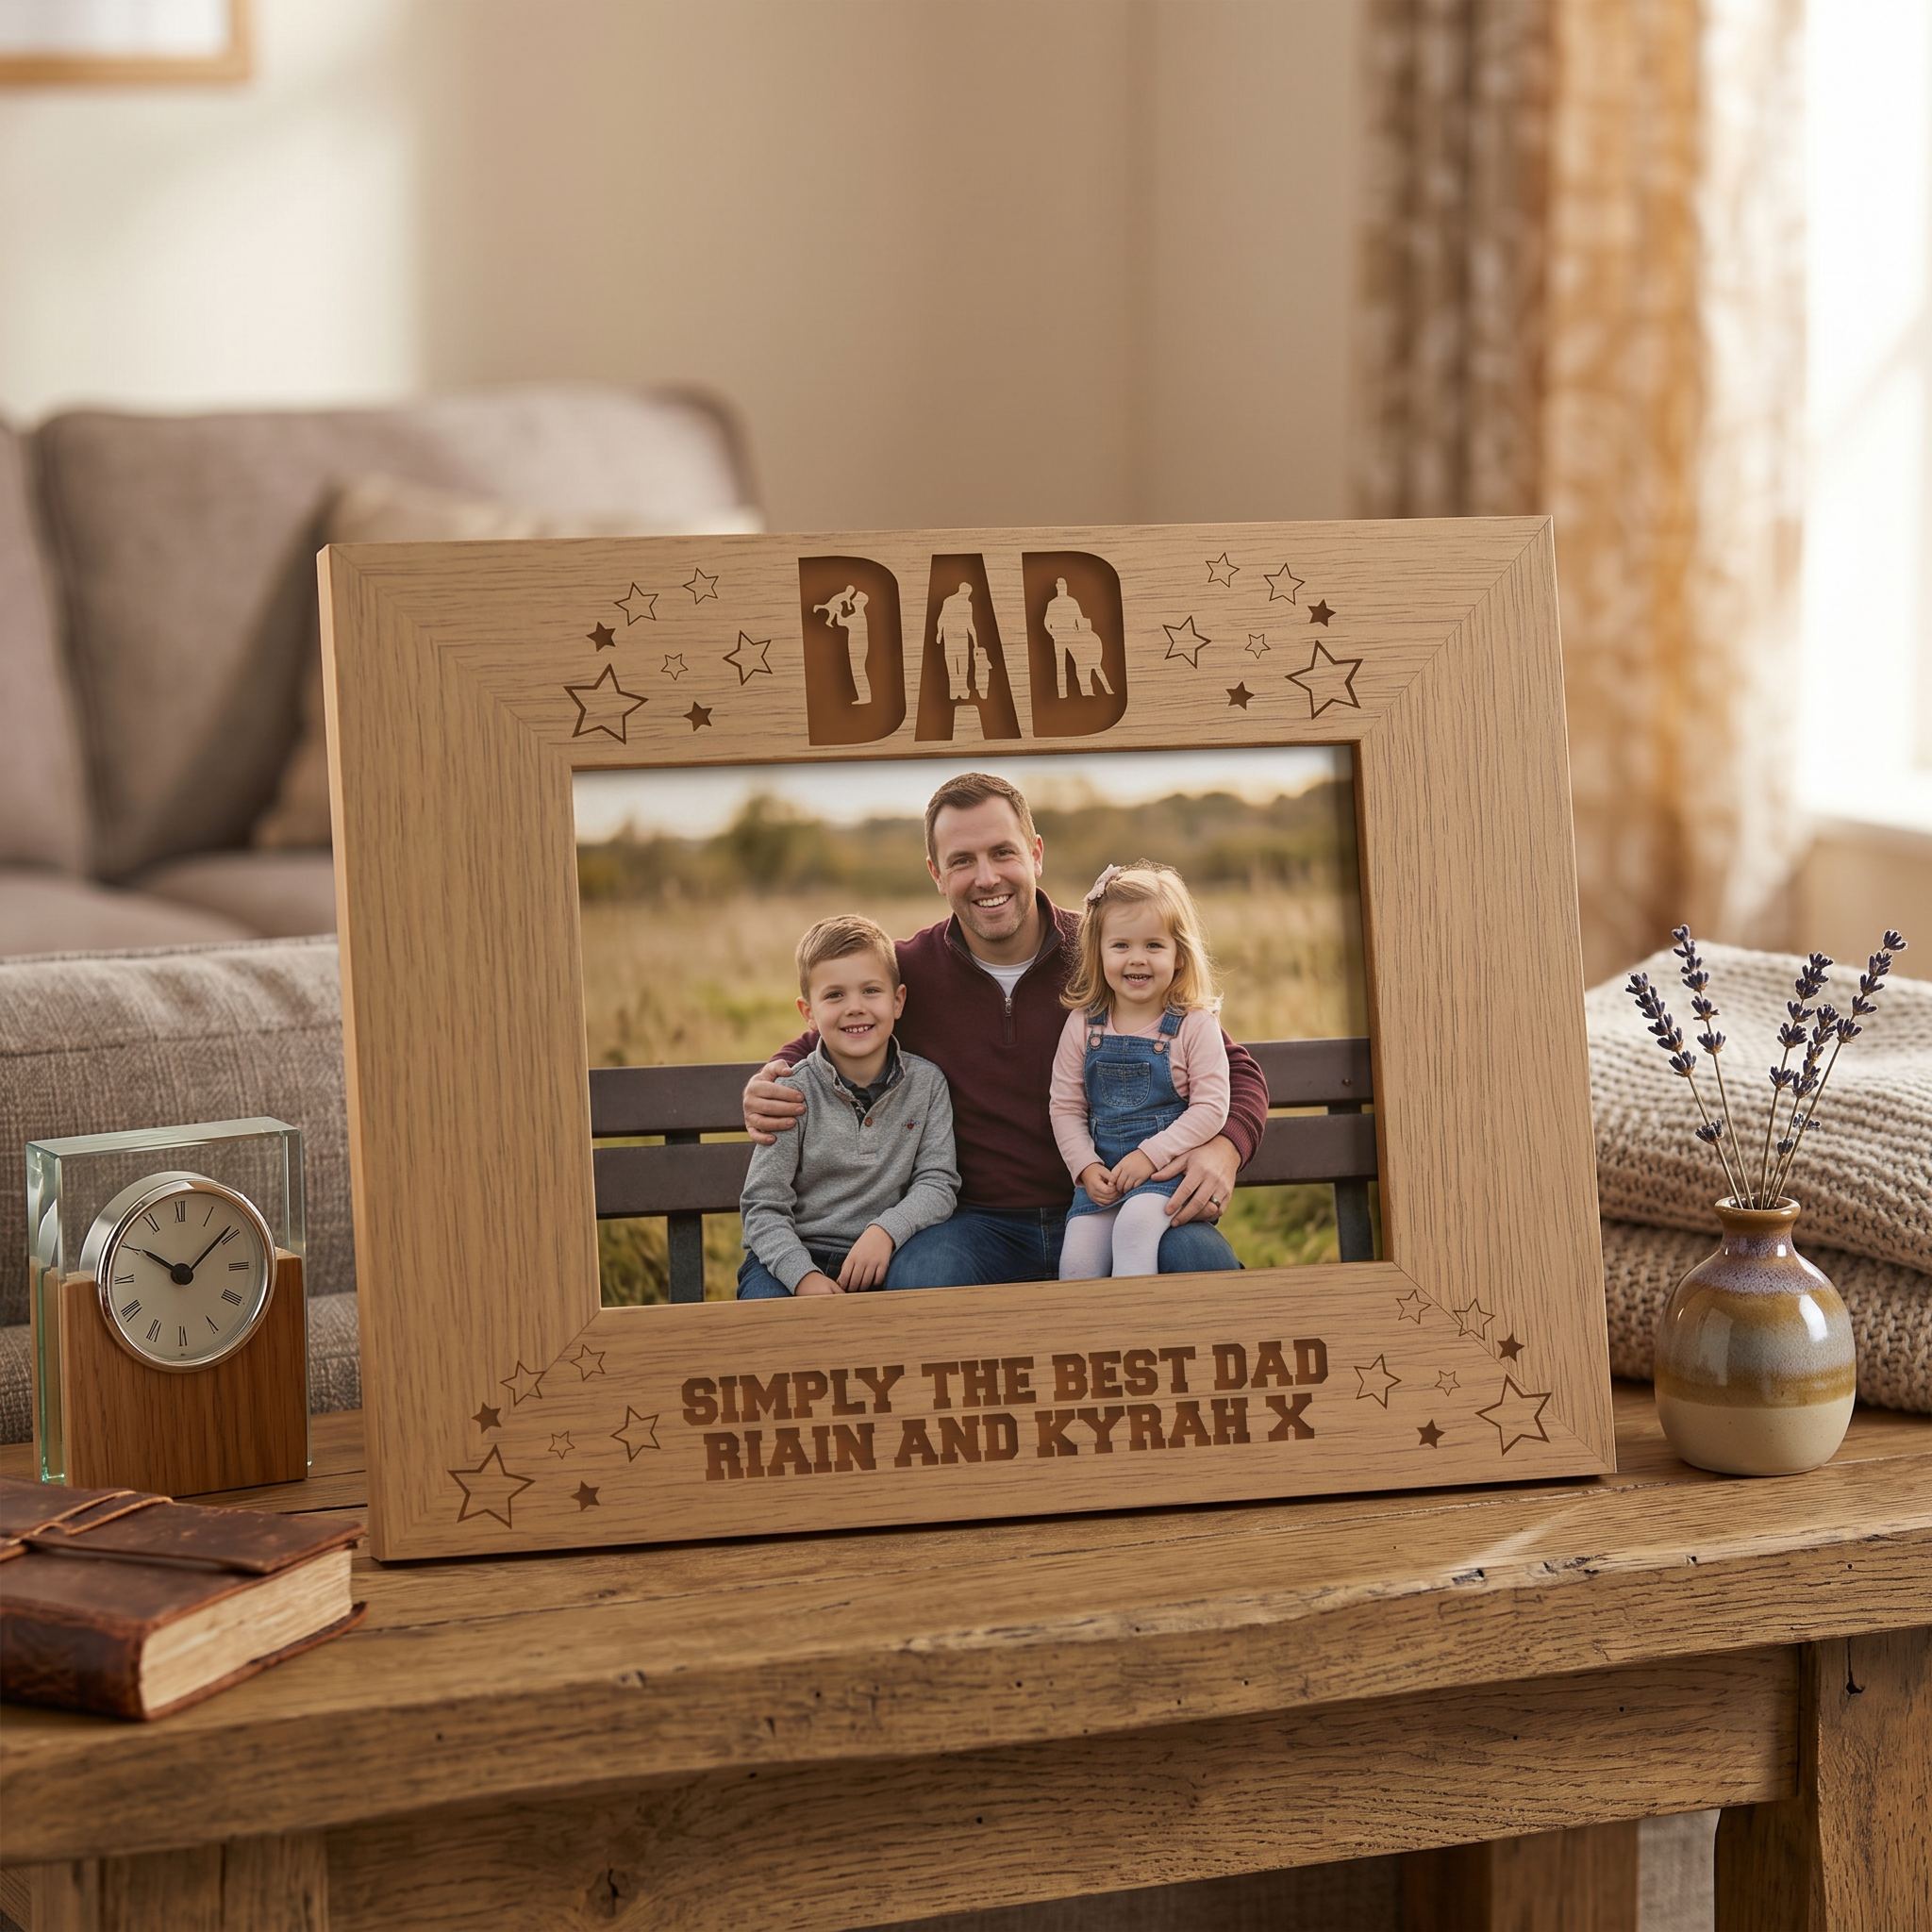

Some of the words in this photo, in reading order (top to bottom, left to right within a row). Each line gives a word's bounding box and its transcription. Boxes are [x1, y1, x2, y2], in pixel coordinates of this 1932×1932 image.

[798, 551, 1128, 746] DAD
[228, 1261, 249, 1272] III
[682, 1364, 905, 1426] SIMPLY
[921, 1357, 1037, 1410] THE
[1052, 1346, 1196, 1402] BEST
[1212, 1338, 1329, 1391] DAD
[704, 1423, 877, 1481] RIAIN
[894, 1412, 1019, 1468] AND
[1034, 1397, 1251, 1458] KYRAH
[1265, 1392, 1315, 1442] X
